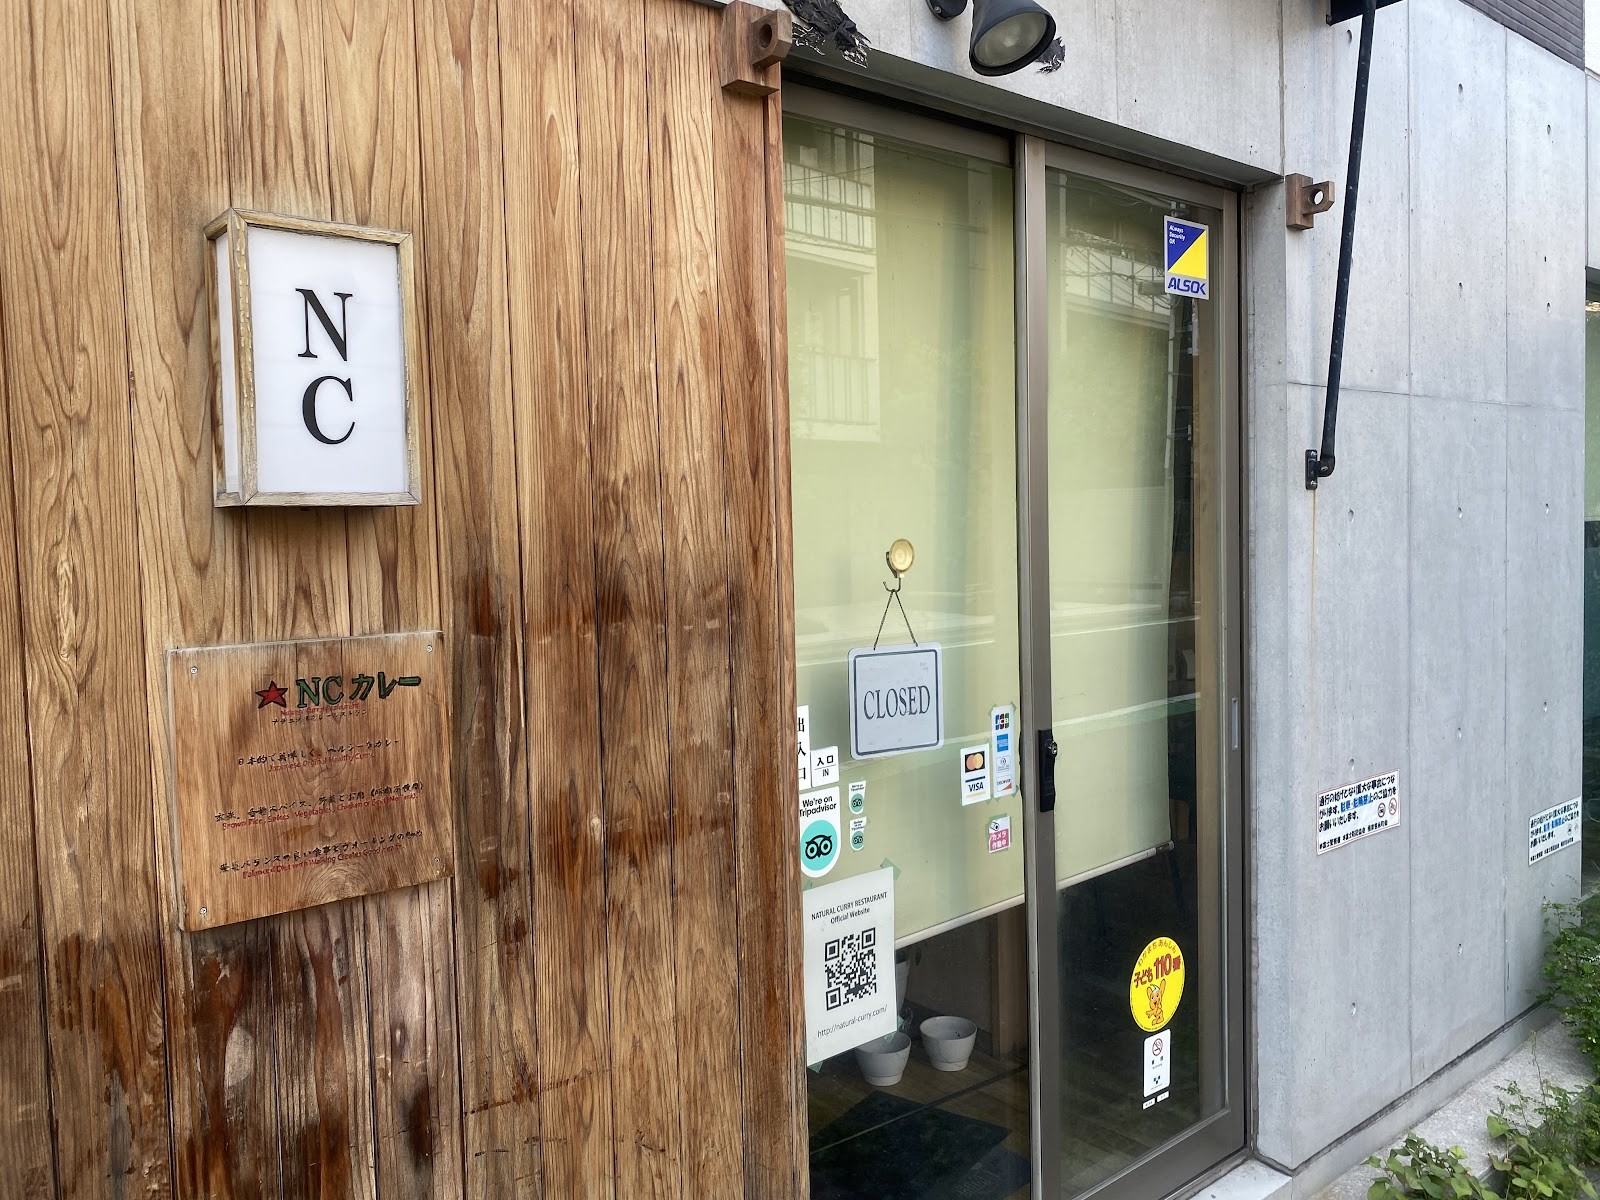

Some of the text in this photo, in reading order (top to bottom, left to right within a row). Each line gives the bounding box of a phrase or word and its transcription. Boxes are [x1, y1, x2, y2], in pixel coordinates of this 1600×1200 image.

[1169, 225, 1184, 234] Always
[1169, 232, 1186, 242] Security
[1168, 277, 1206, 295] ALSOK
[296, 671, 422, 709] NC カレー
[863, 685, 931, 720] CLOSED
[816, 755, 834, 767] 入口
[822, 768, 830, 777] IN
[968, 782, 984, 792] VISA
[802, 795, 833, 808] We're on
[799, 802, 837, 818] Tripadvisor
[991, 830, 1006, 841] カメラ
[811, 891, 888, 921] NATURAL CURRY RESTAURANT
[830, 906, 871, 925] Official Website
[817, 1004, 888, 1038] http://natural-curry.com/
